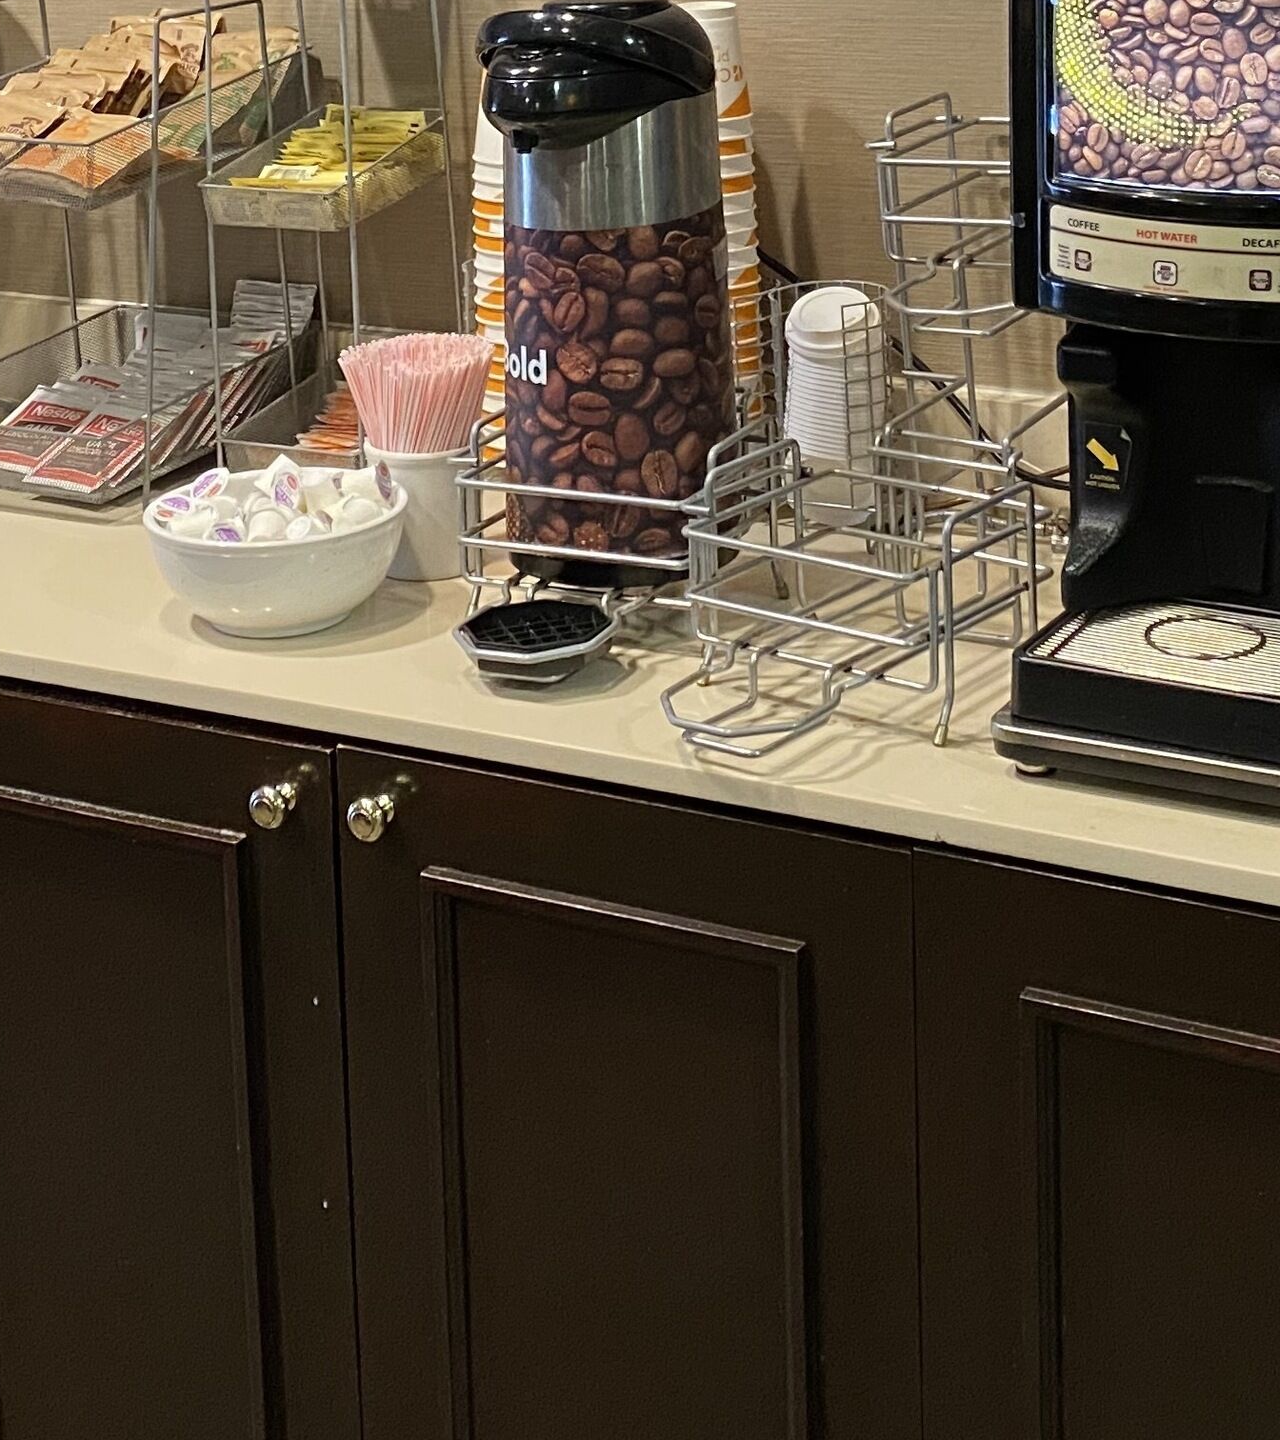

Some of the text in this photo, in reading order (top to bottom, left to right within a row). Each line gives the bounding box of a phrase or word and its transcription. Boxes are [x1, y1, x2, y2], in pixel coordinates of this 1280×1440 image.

[1067, 217, 1100, 232] COFFEE
[1136, 229, 1198, 245] HOT WATER
[1242, 237, 1280, 249] DECAF
